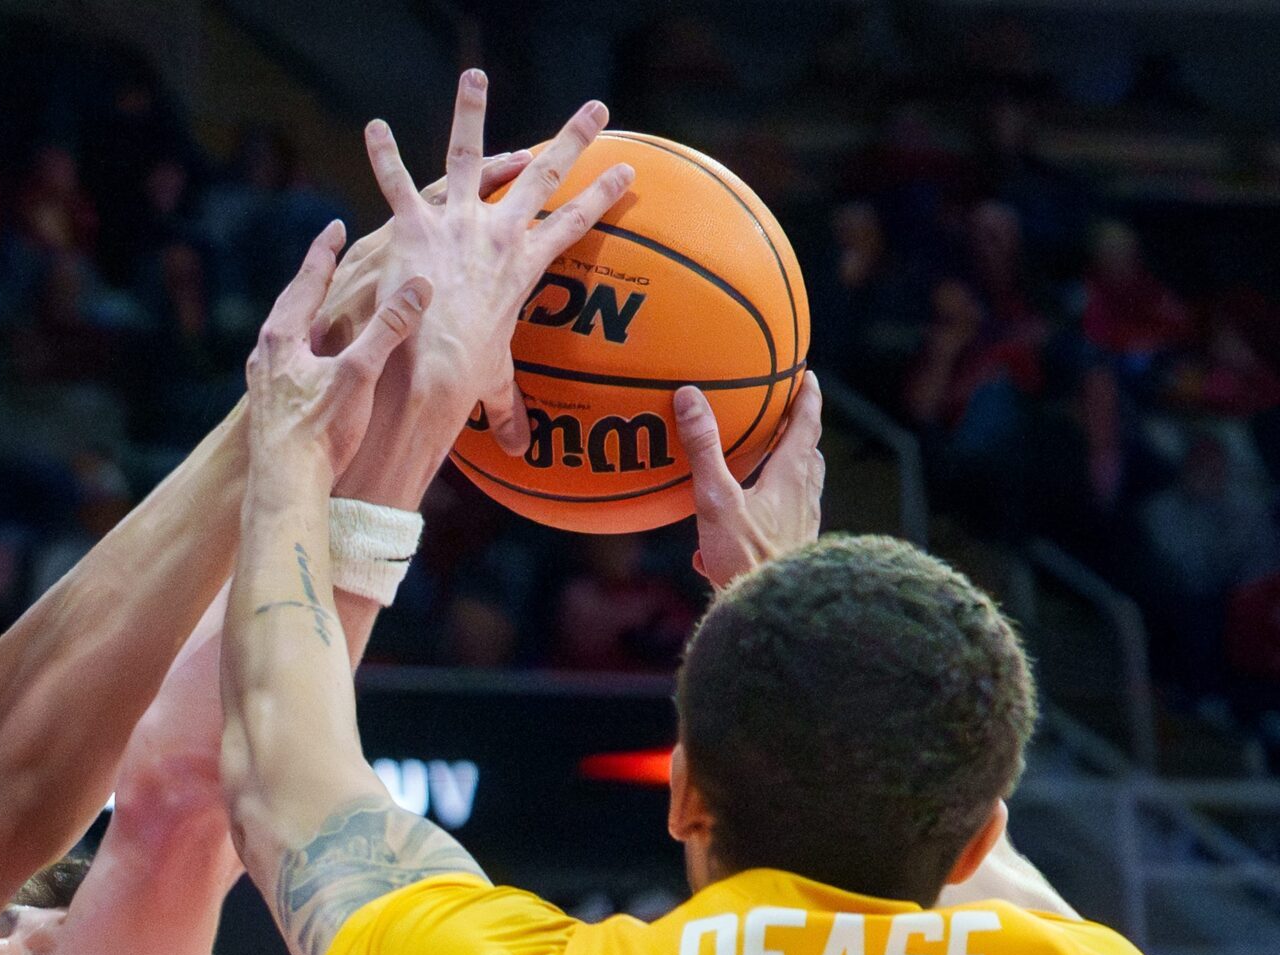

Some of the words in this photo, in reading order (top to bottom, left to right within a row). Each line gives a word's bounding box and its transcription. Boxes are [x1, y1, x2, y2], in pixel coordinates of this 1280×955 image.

[572, 258, 651, 287] OFFICIAL
[516, 273, 647, 345] NC
[466, 400, 676, 475] Wil
